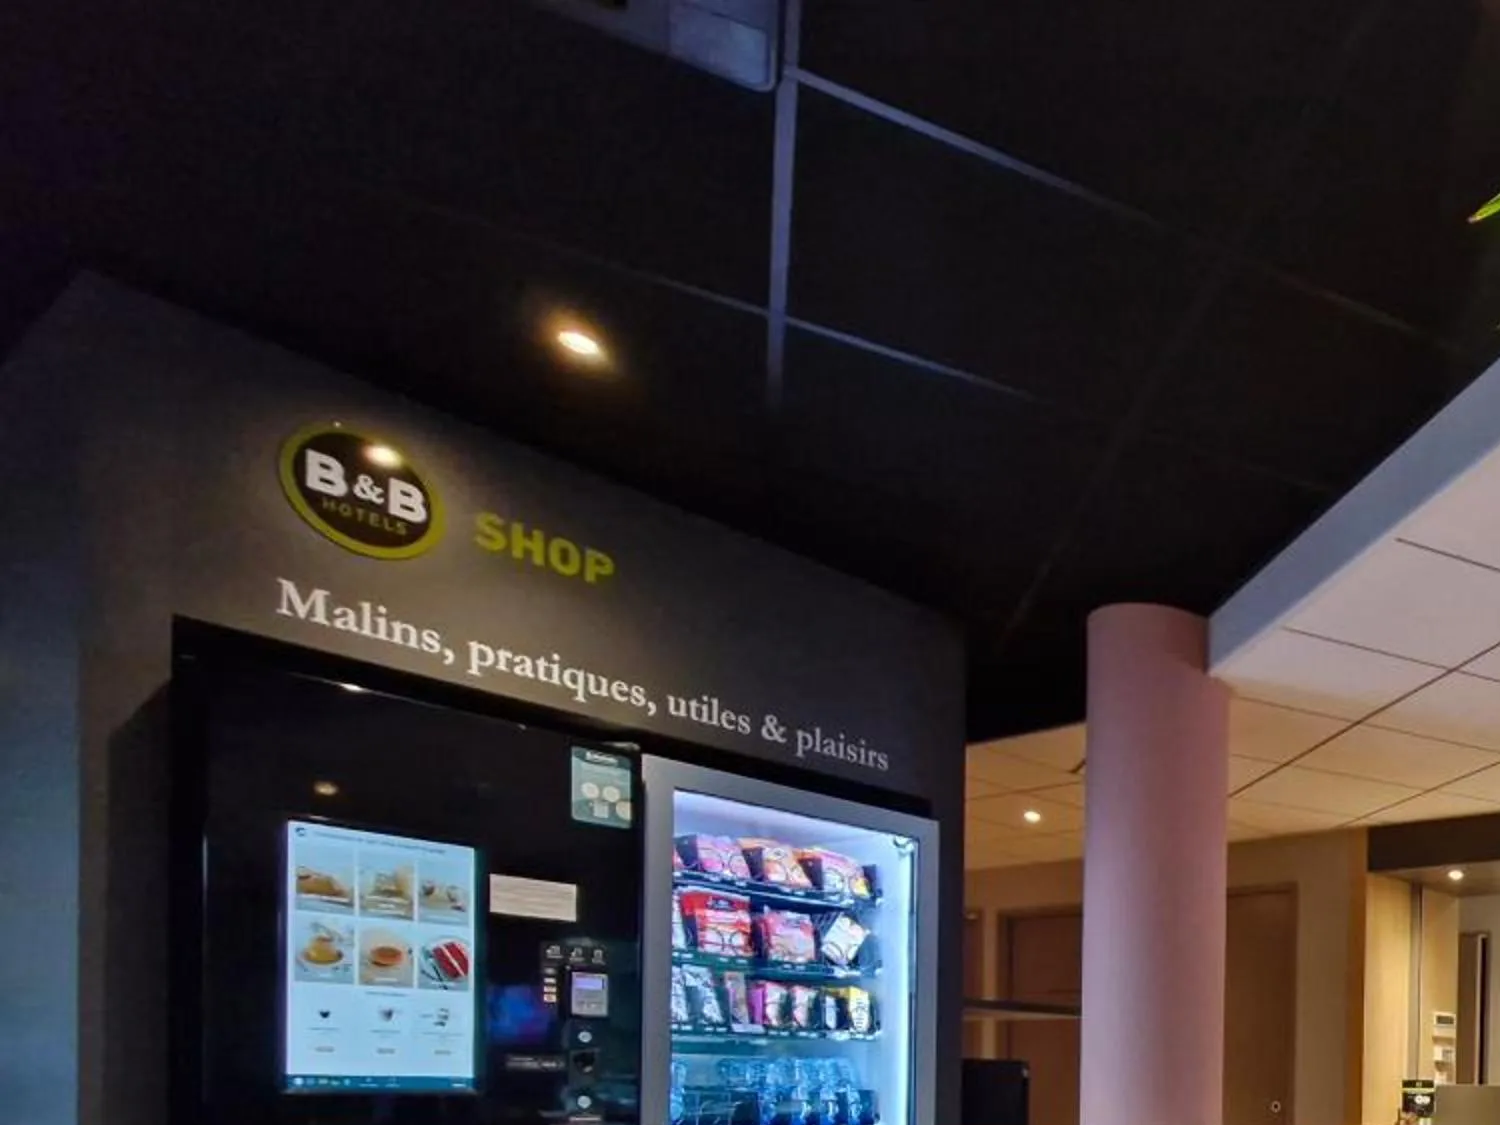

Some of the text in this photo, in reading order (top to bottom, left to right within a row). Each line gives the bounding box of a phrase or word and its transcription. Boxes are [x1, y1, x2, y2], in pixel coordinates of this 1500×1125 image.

[305, 448, 427, 523] B&B
[321, 497, 407, 535] HOTELS
[474, 512, 615, 584] SHOP
[275, 577, 890, 772] Malins, pratiques, utiles & plaisirs
